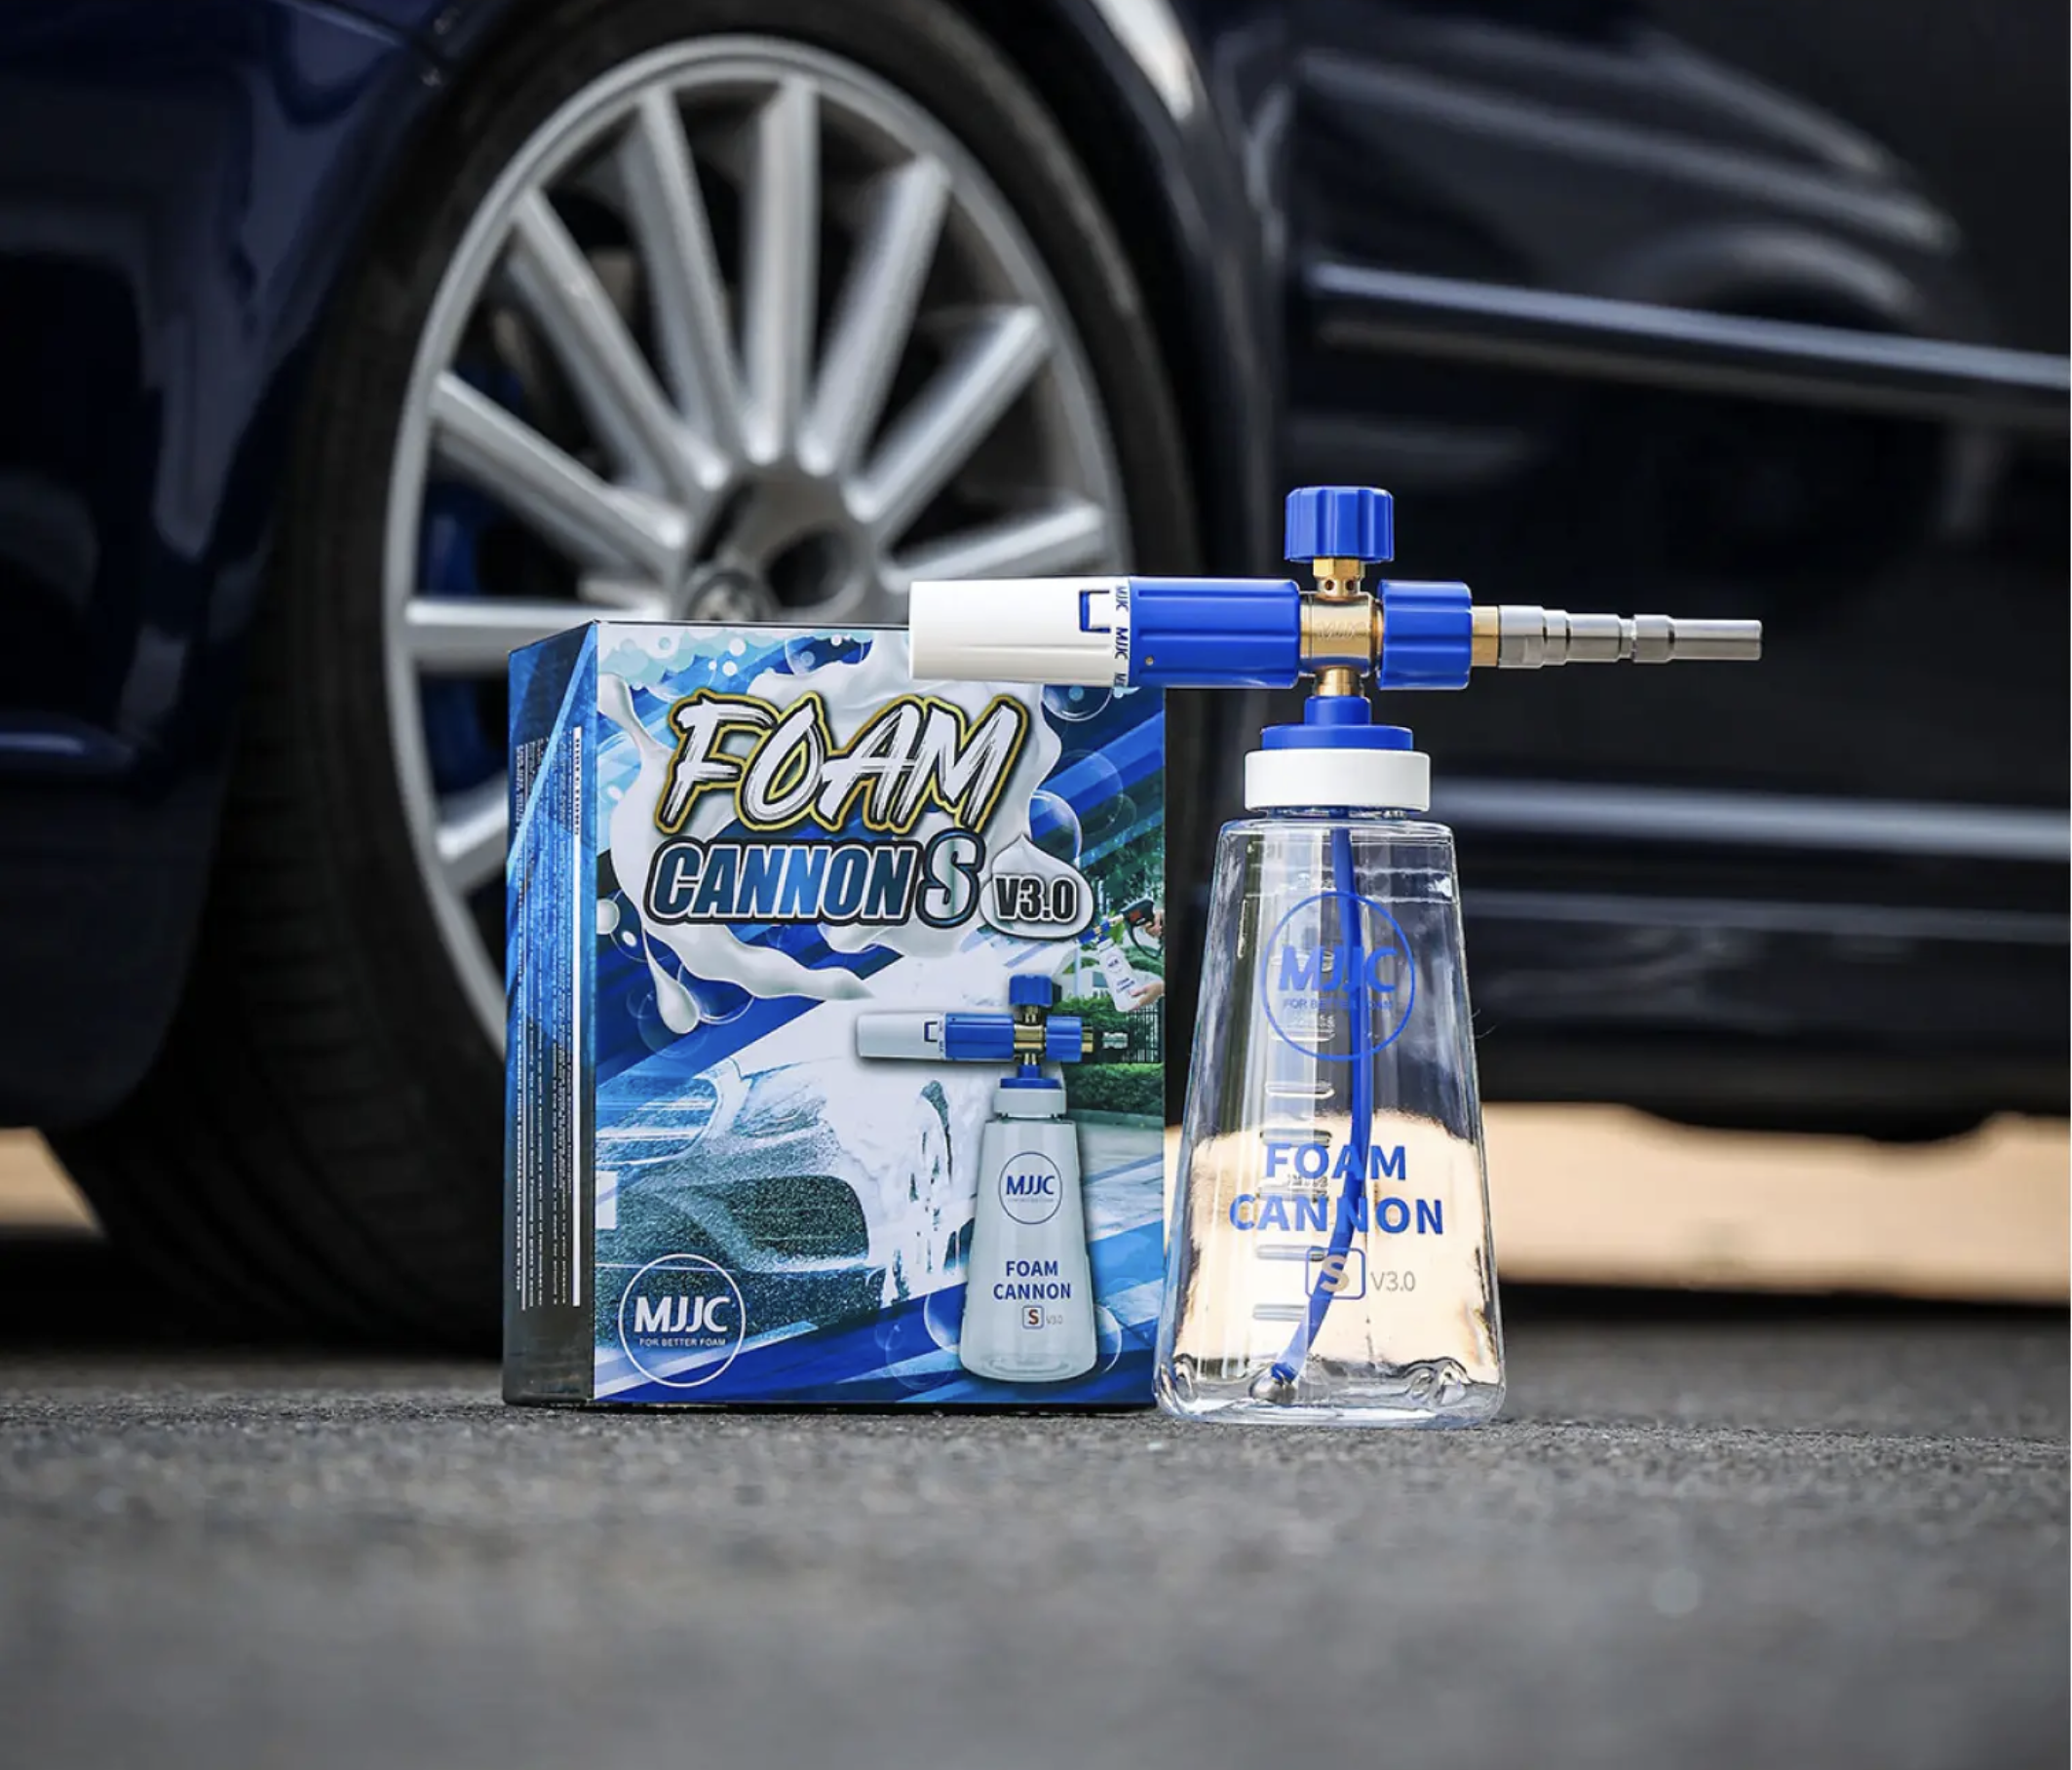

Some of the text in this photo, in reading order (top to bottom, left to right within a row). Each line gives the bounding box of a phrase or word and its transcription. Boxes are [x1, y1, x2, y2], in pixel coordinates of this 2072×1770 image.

[1115, 626, 1130, 660] MJJC
[657, 692, 1026, 831] FOAM
[648, 828, 1078, 928] CANNON S V3.0
[1278, 944, 1399, 992] MJJC
[1283, 997, 1308, 1011] FOR
[1265, 1142, 1407, 1181] FOAM
[1006, 1174, 1055, 1196] MJJC
[1229, 1193, 1444, 1236] CANNON
[1005, 1260, 1058, 1278] FOAM
[1320, 1253, 1416, 1292] S V3.0
[993, 1283, 1072, 1300] CANNON
[633, 1295, 731, 1333] MJJC
[1027, 1308, 1040, 1326] S
[639, 1336, 727, 1348] FOR BETTER FOAM
